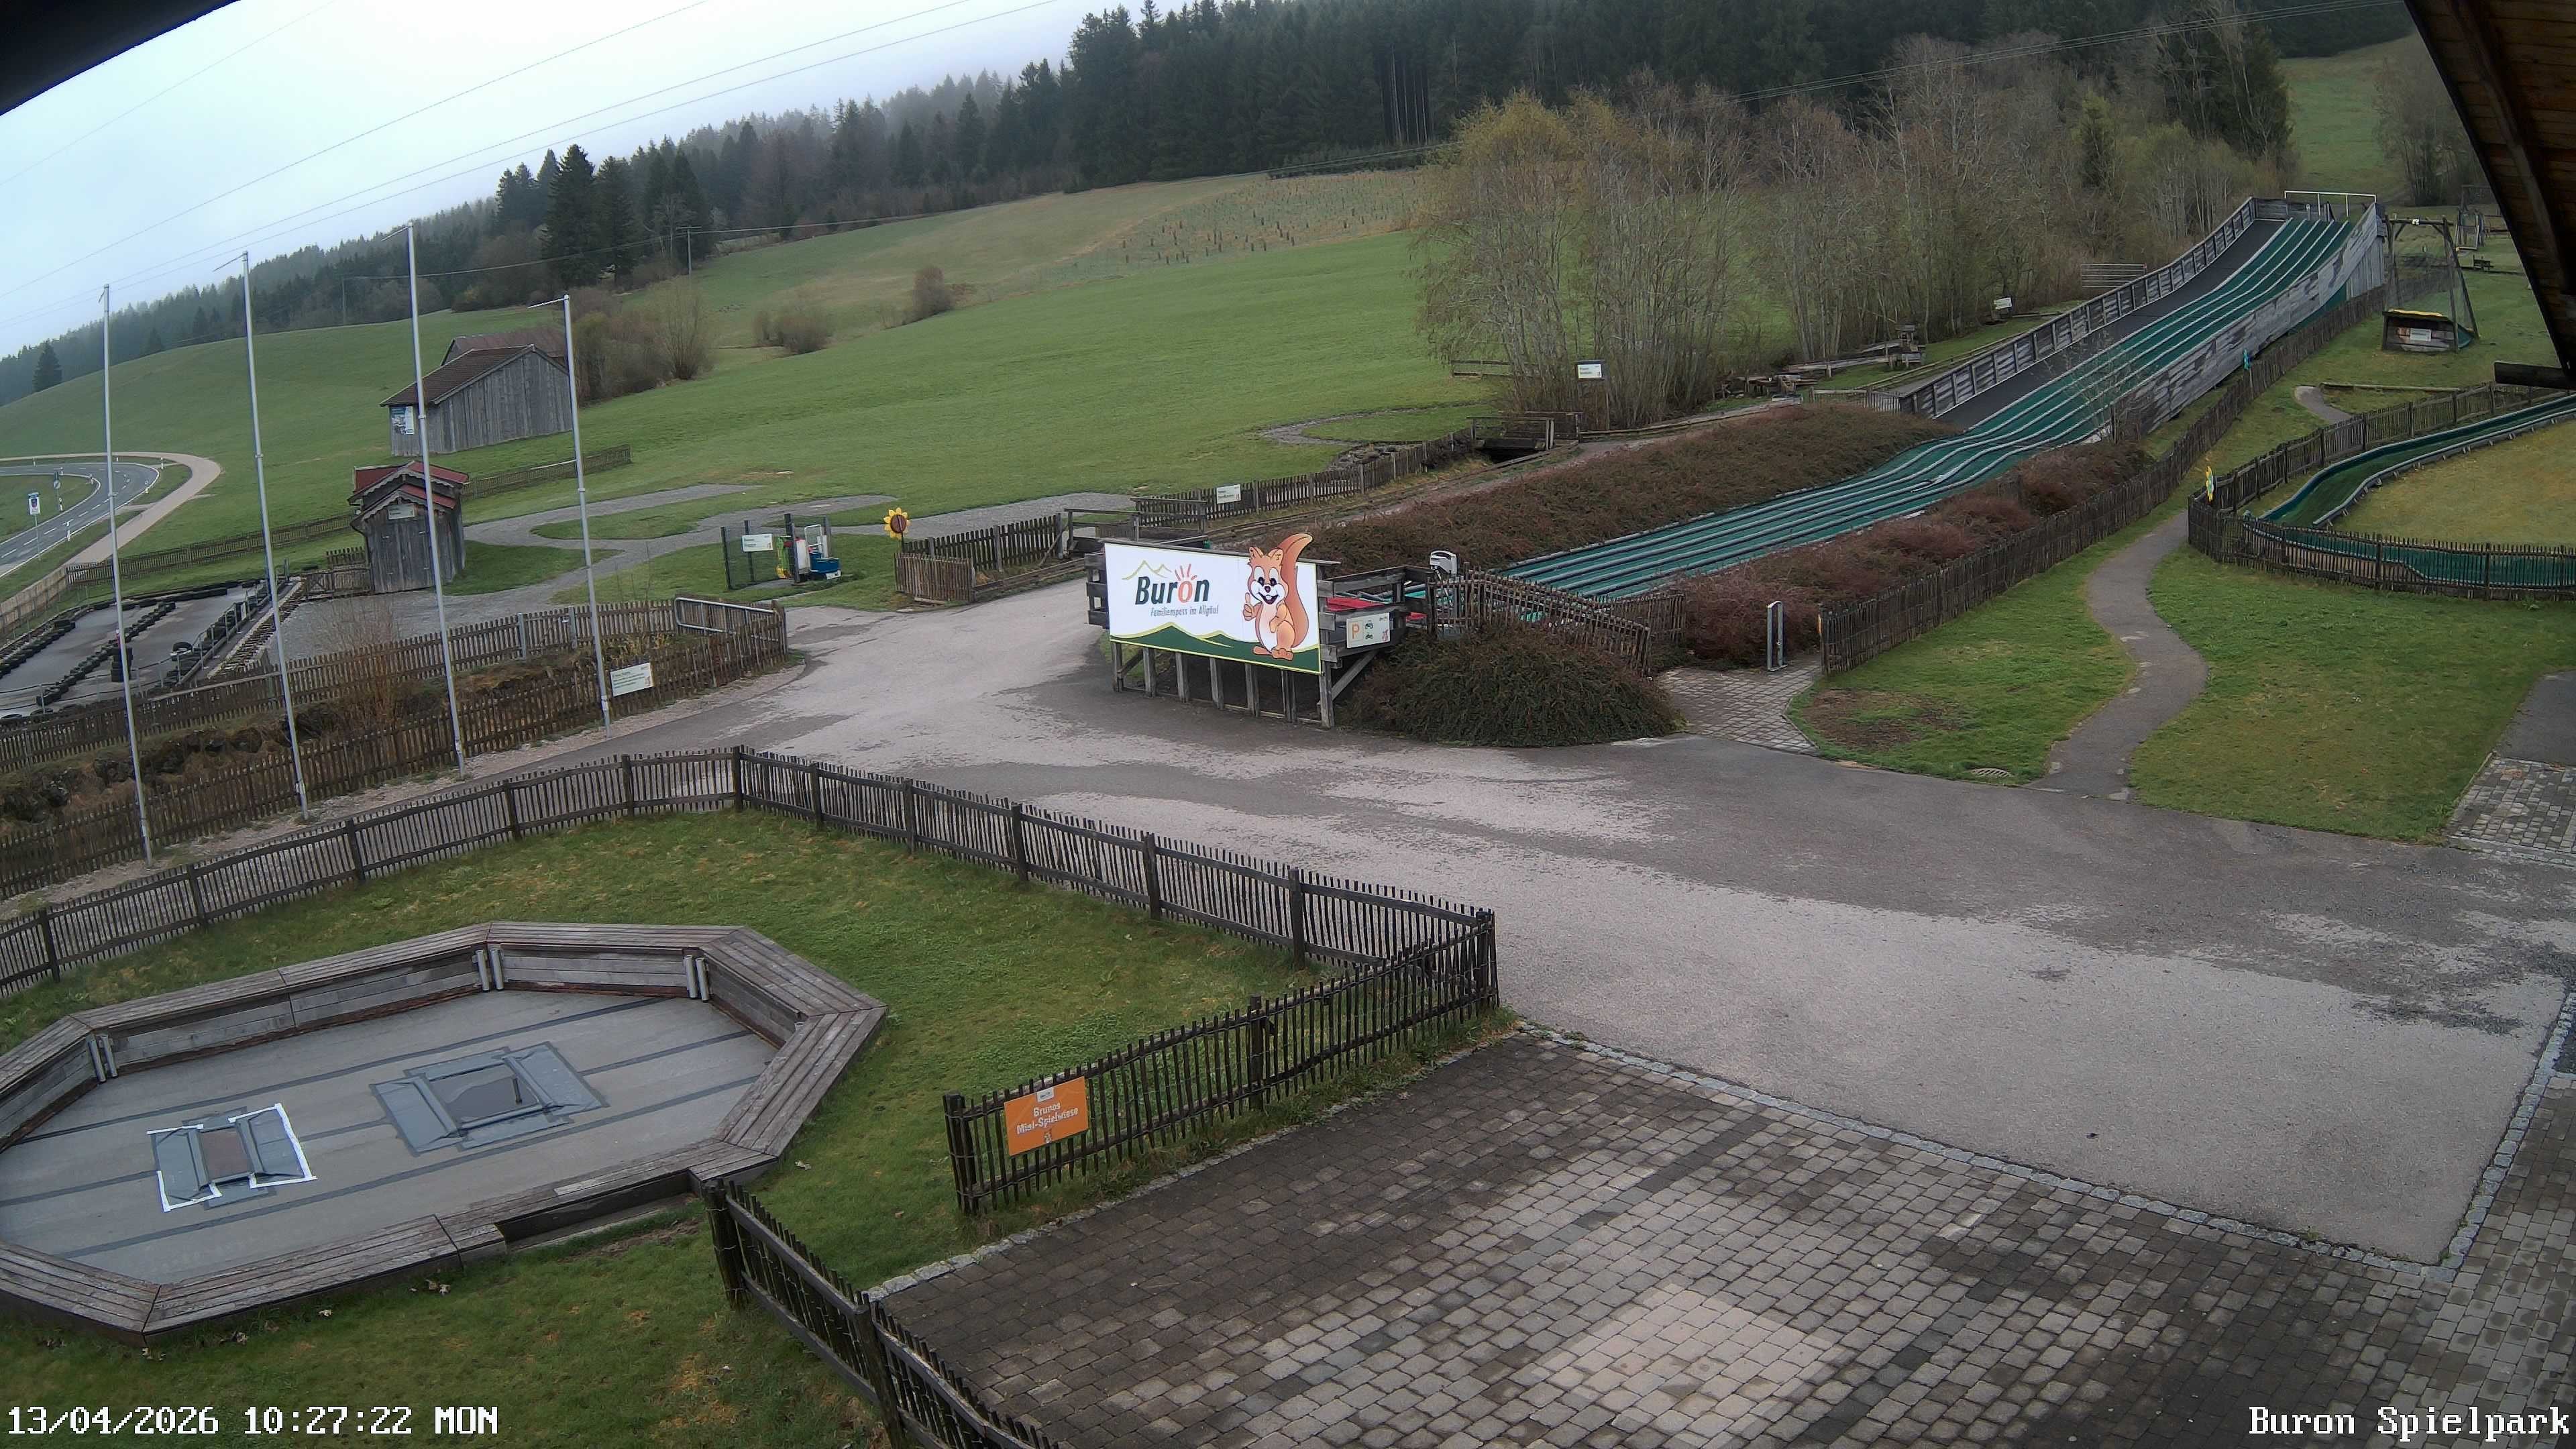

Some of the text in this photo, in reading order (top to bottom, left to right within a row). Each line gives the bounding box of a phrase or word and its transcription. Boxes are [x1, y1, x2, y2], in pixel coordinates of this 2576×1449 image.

[1135, 576, 1210, 605] Buron
[1189, 606, 1197, 615] im
[1352, 624, 1359, 639] P
[1016, 1108, 1079, 1135] Mini-Spielwiese
